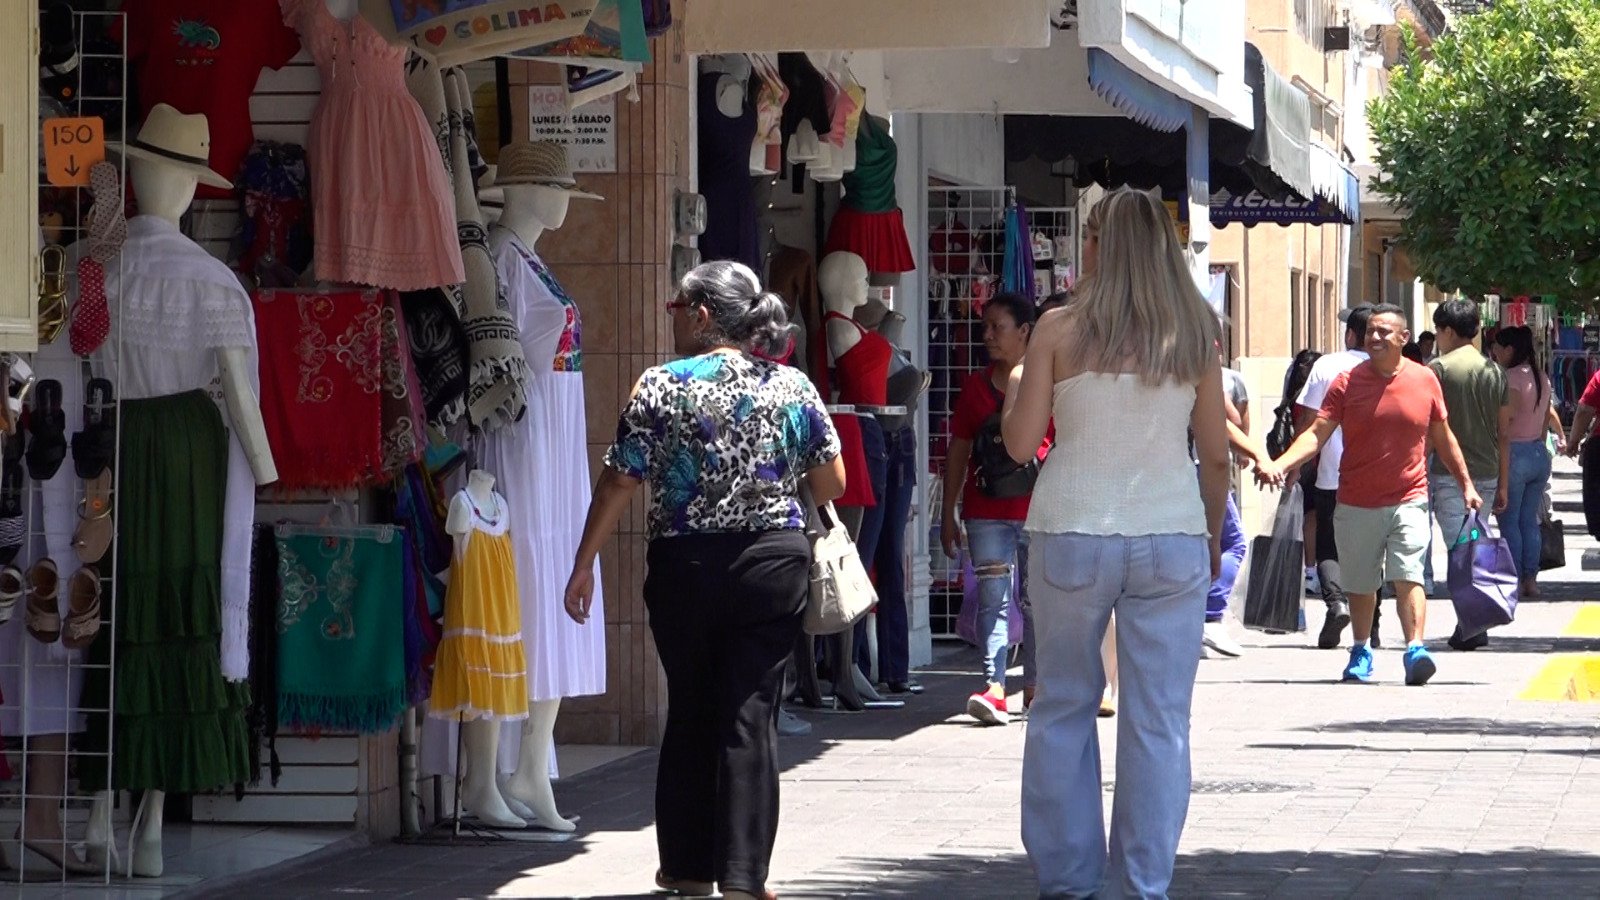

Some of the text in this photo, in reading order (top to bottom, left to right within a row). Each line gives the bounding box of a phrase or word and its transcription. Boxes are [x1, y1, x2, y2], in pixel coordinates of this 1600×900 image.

[454, 3, 566, 39] COLIMA
[532, 116, 561, 124] LUNES
[572, 114, 612, 124] SÁBADO
[52, 125, 93, 145] 150
